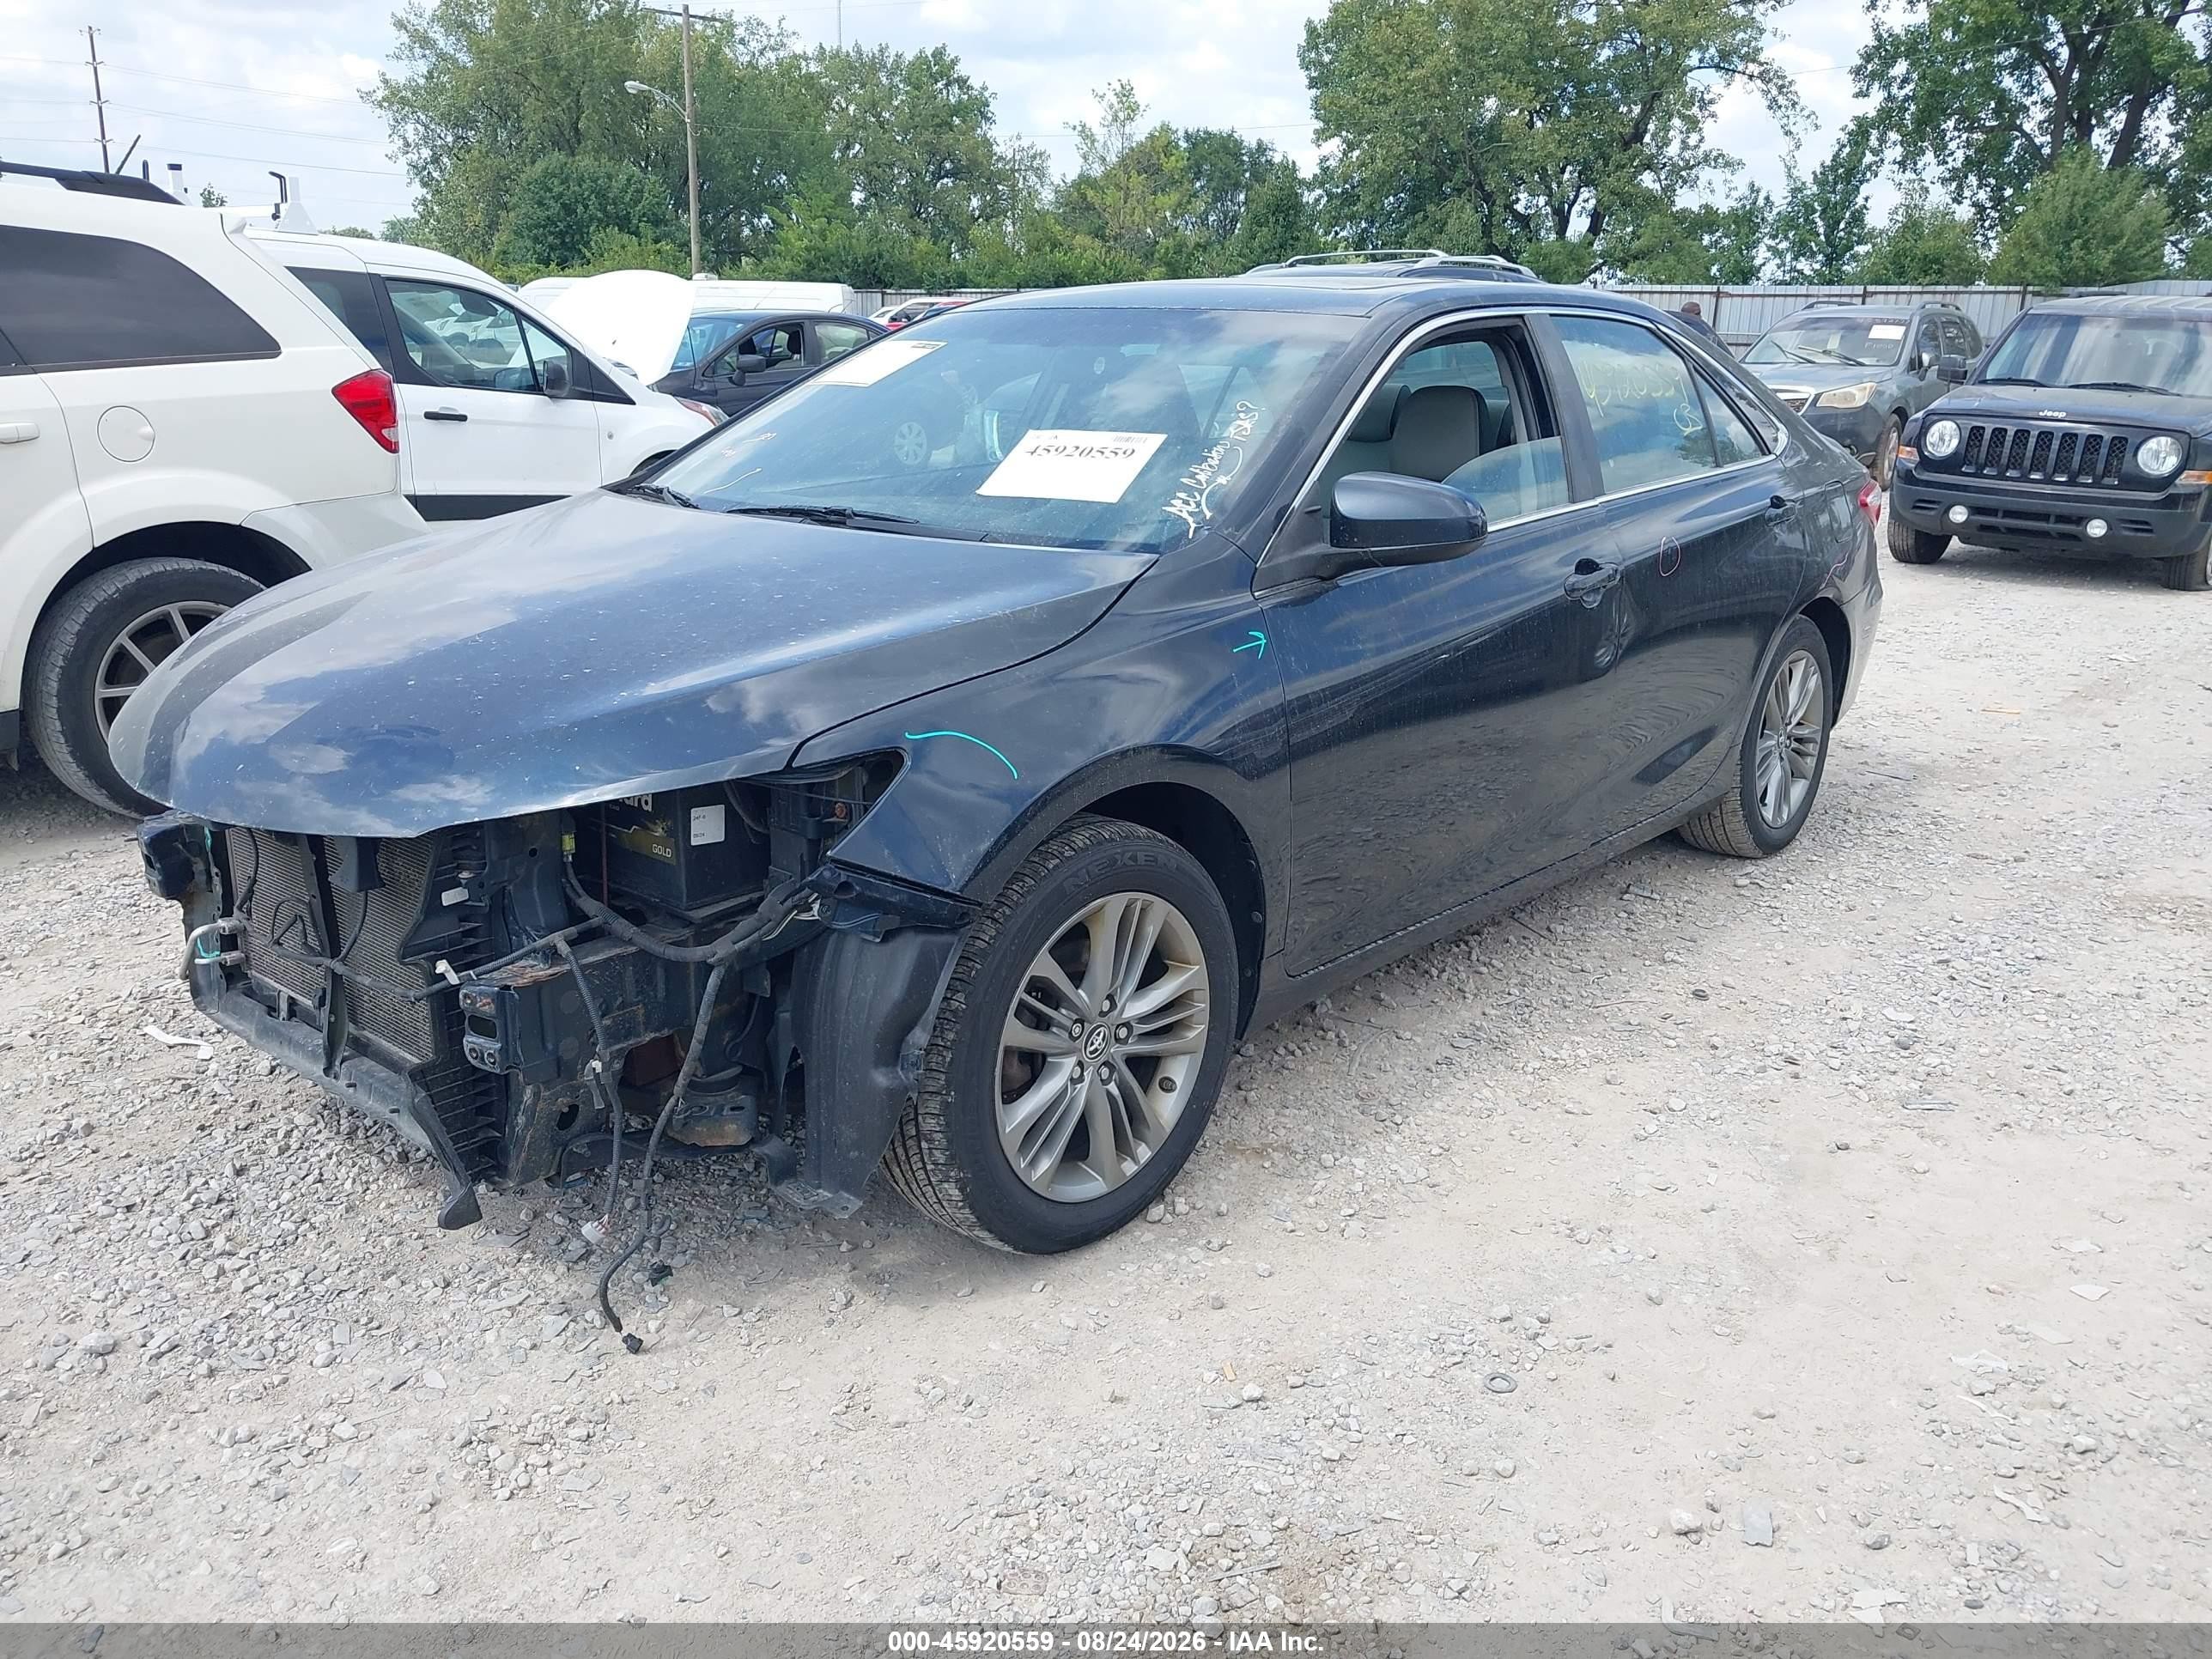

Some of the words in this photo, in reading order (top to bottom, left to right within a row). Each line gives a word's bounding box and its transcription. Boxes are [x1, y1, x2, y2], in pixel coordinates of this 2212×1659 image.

[2039, 410, 2067, 418] Jeep
[1024, 445, 1136, 459] 45920559
[653, 844, 672, 857] GOLD
[1062, 851, 1178, 895] NEXEN
